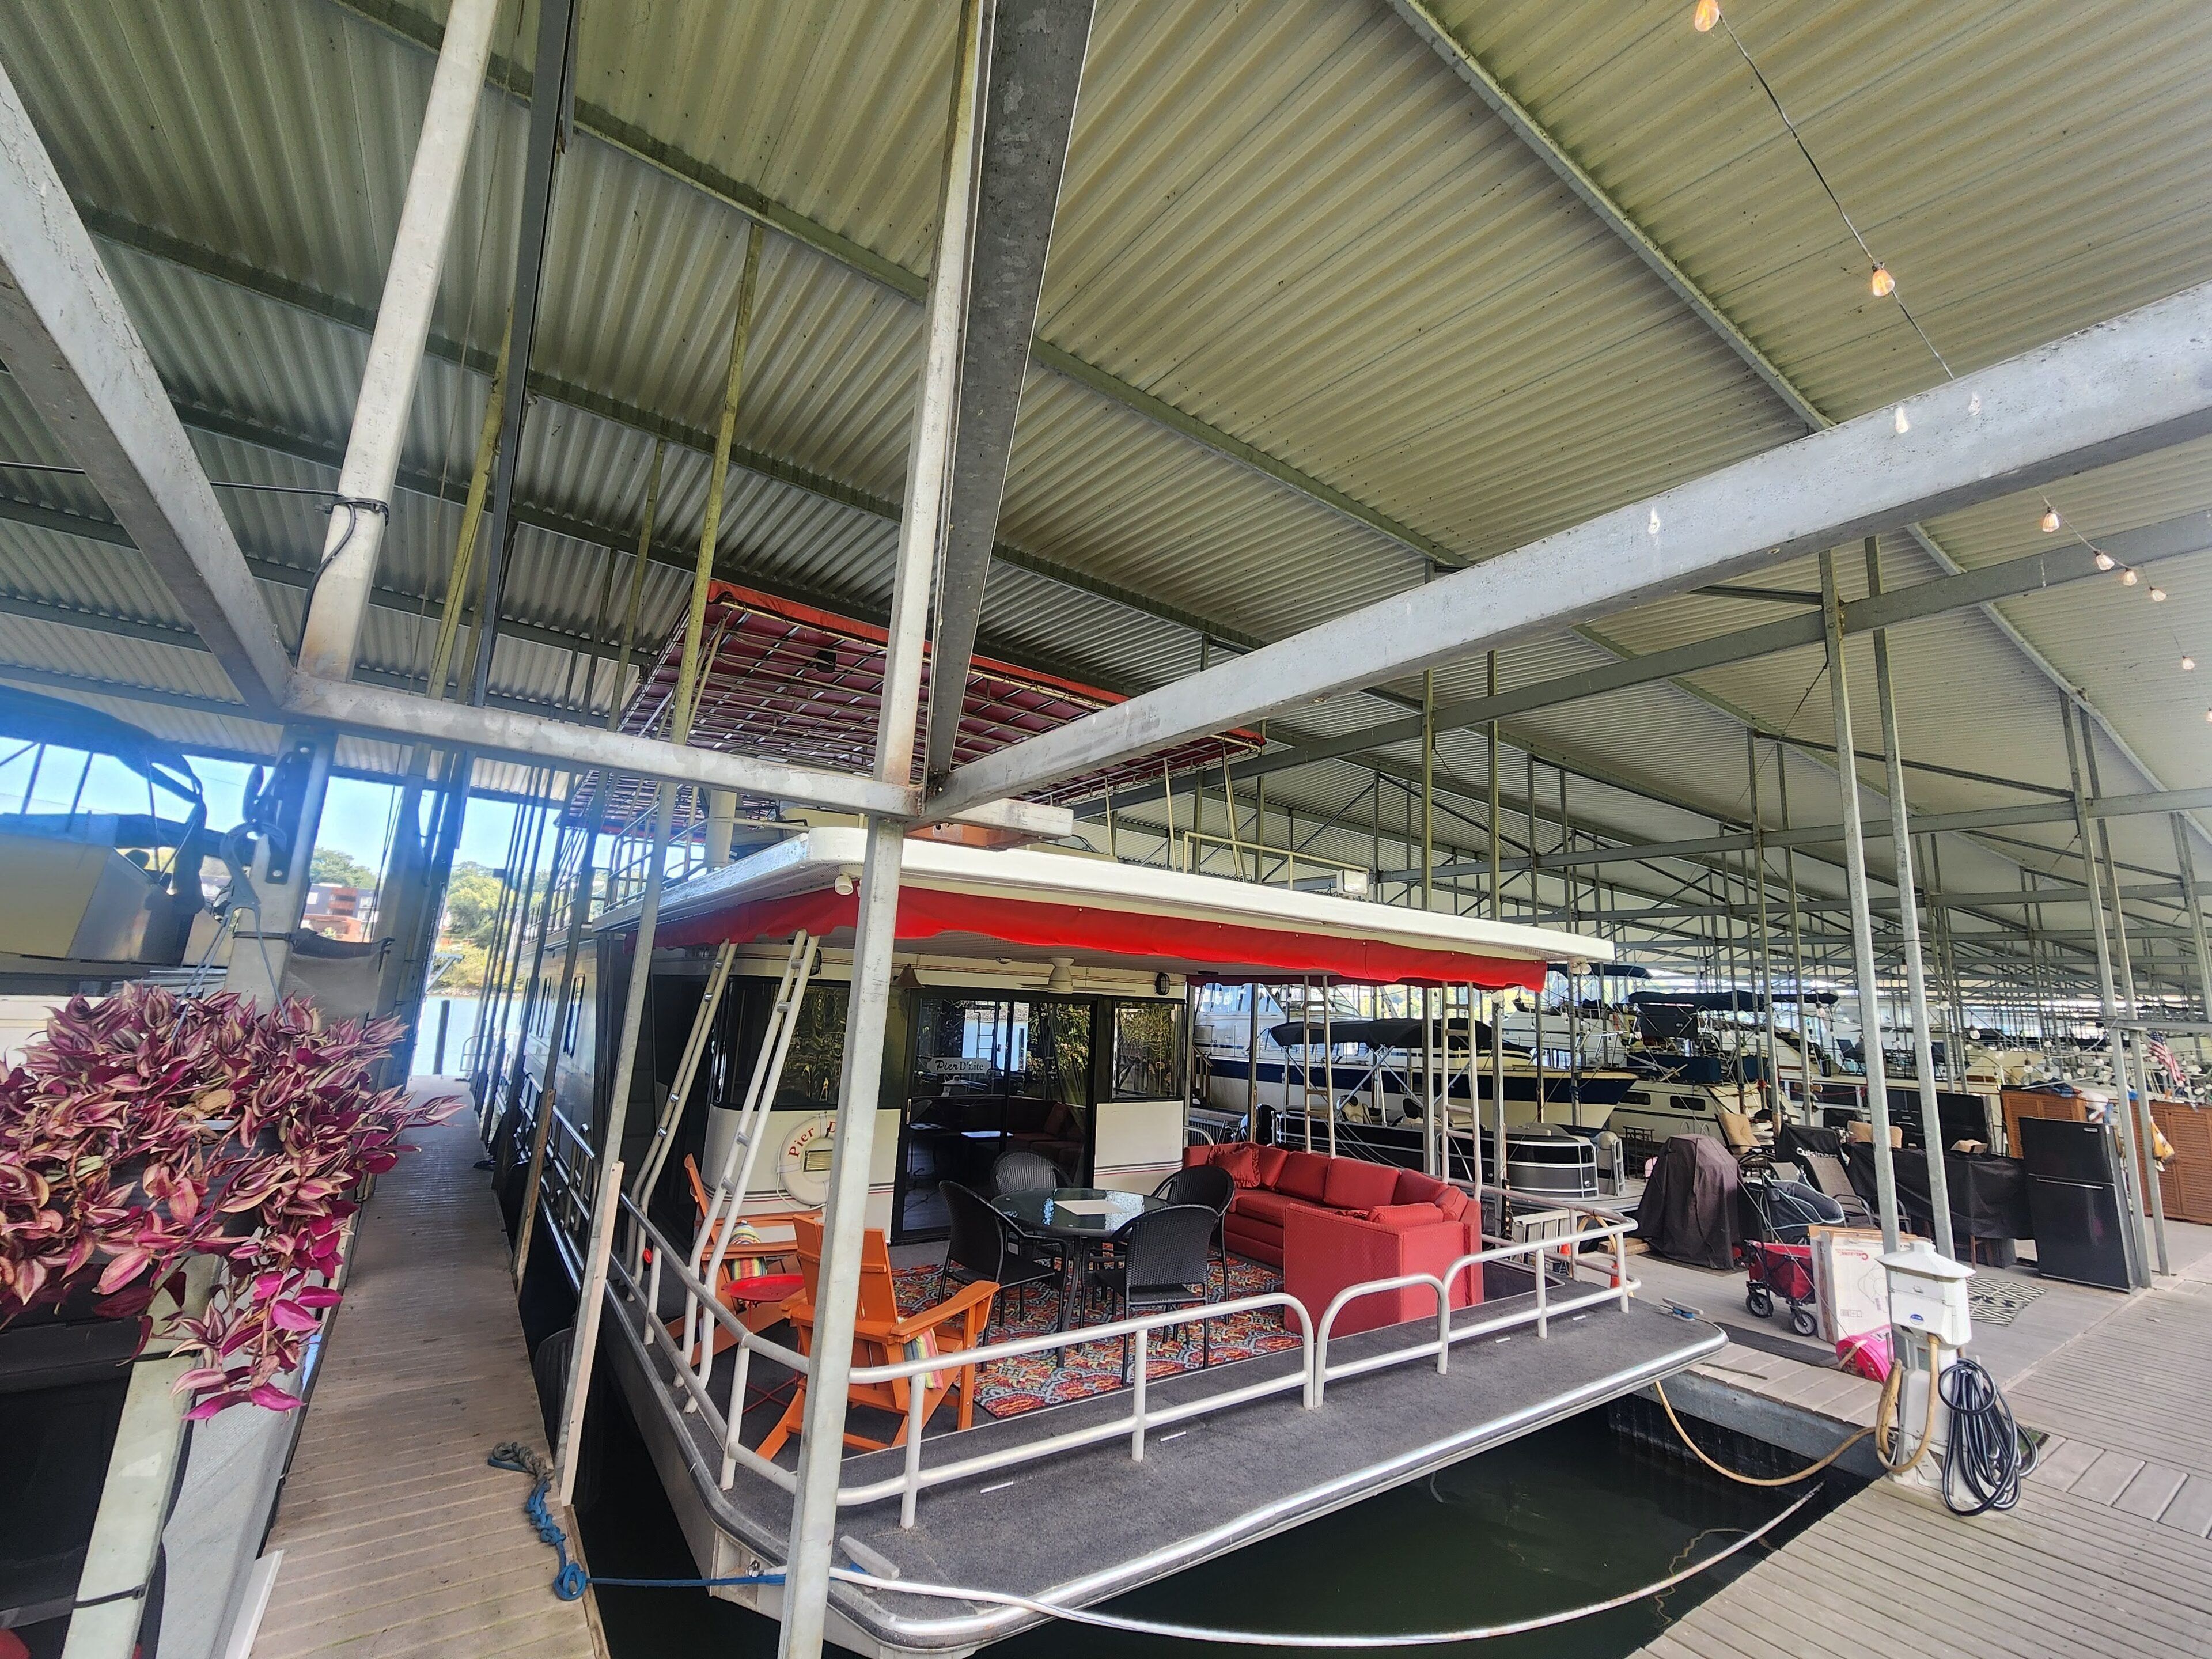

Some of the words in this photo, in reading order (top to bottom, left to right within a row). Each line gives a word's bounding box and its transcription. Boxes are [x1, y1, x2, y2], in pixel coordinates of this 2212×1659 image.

[935, 1060, 959, 1071] Pier
[788, 1127, 814, 1157] Pier
[1796, 1147, 1838, 1158] Cuisinart
